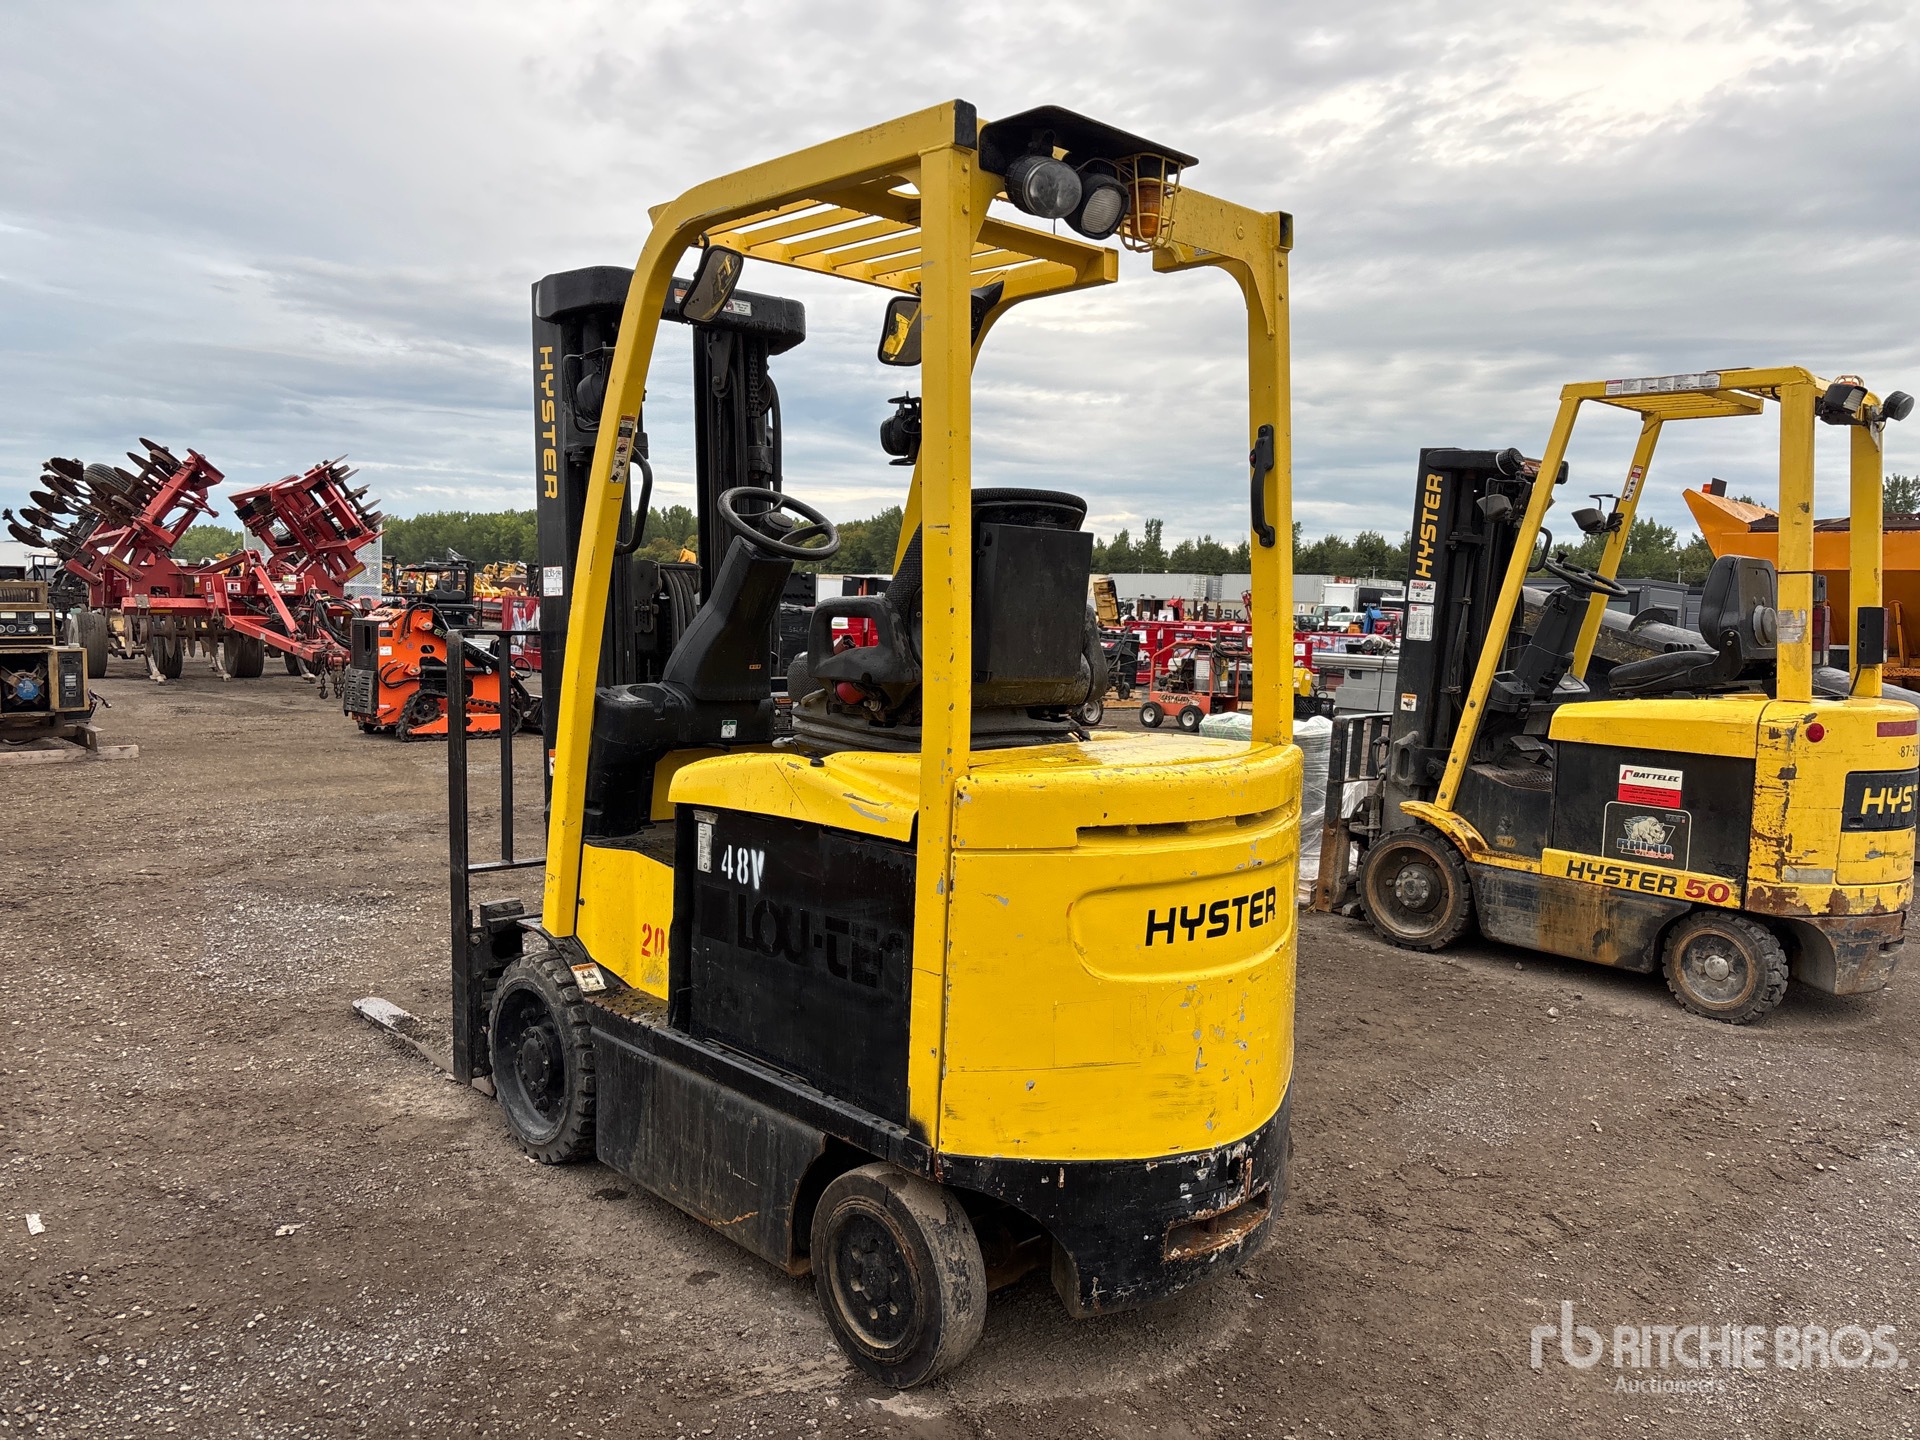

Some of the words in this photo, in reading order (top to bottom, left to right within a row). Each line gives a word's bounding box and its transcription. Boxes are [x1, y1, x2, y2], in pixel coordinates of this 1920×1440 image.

[539, 346, 558, 499] HYSTER
[1415, 473, 1443, 578] HYSTER
[1632, 771, 1680, 783] BATTELEC
[721, 844, 765, 890] 48V
[1616, 837, 1673, 855] RHINO
[1566, 859, 1678, 895] HYSTER
[1684, 878, 1730, 903] 50
[1145, 886, 1276, 947] HYSTER
[641, 922, 665, 957] 20
